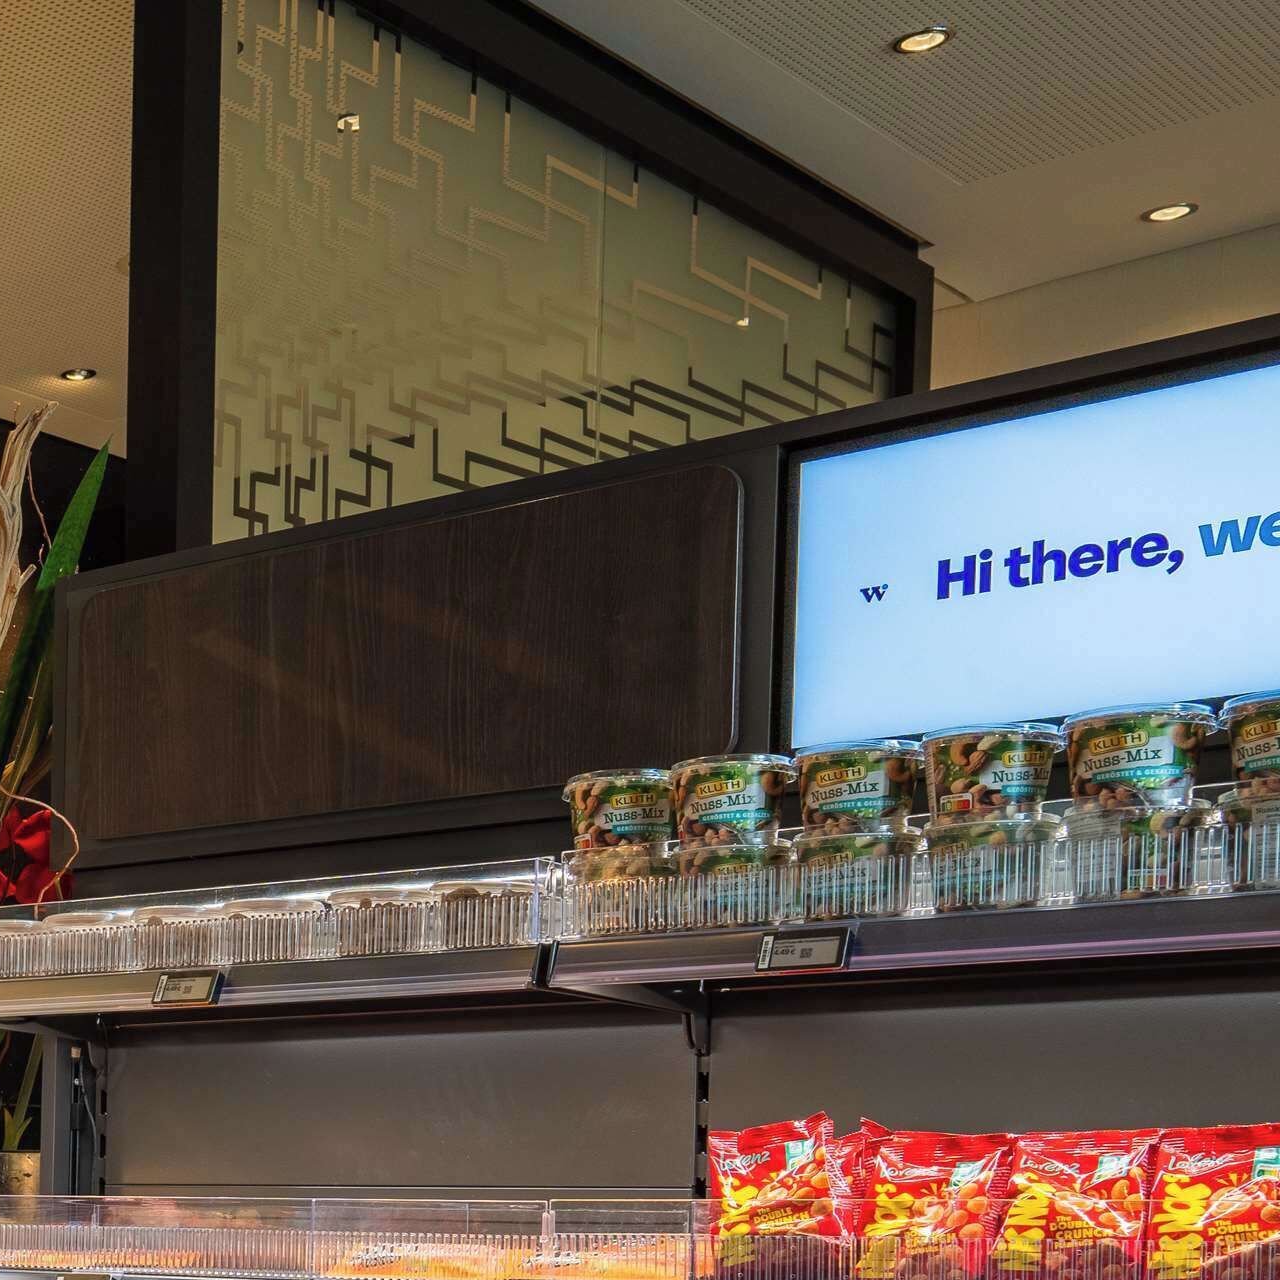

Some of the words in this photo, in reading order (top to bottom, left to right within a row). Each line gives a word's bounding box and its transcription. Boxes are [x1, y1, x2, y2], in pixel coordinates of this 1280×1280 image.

[937, 548, 993, 600] Hi
[1004, 531, 1184, 588] there,
[1092, 731, 1143, 751] KLUTH
[1083, 746, 1163, 774] Nuss-Mix
[819, 768, 863, 785] KLUTH
[1096, 770, 1133, 781] GERÖSTET
[698, 780, 741, 795] KLUTH
[810, 782, 880, 803] Nuss-Mix
[614, 794, 654, 807] KLUTH
[689, 793, 758, 815] Nuss-Mix
[602, 808, 666, 824] Nuss-Mix
[1019, 1155, 1080, 1176] Lorenz
[753, 1210, 793, 1224] DOUBLE
[1215, 1220, 1233, 1228] The
[1049, 1220, 1096, 1232] DOUBLE
[1207, 1224, 1259, 1237] DOUBLE
[1055, 1228, 1113, 1242] CRUNCH
